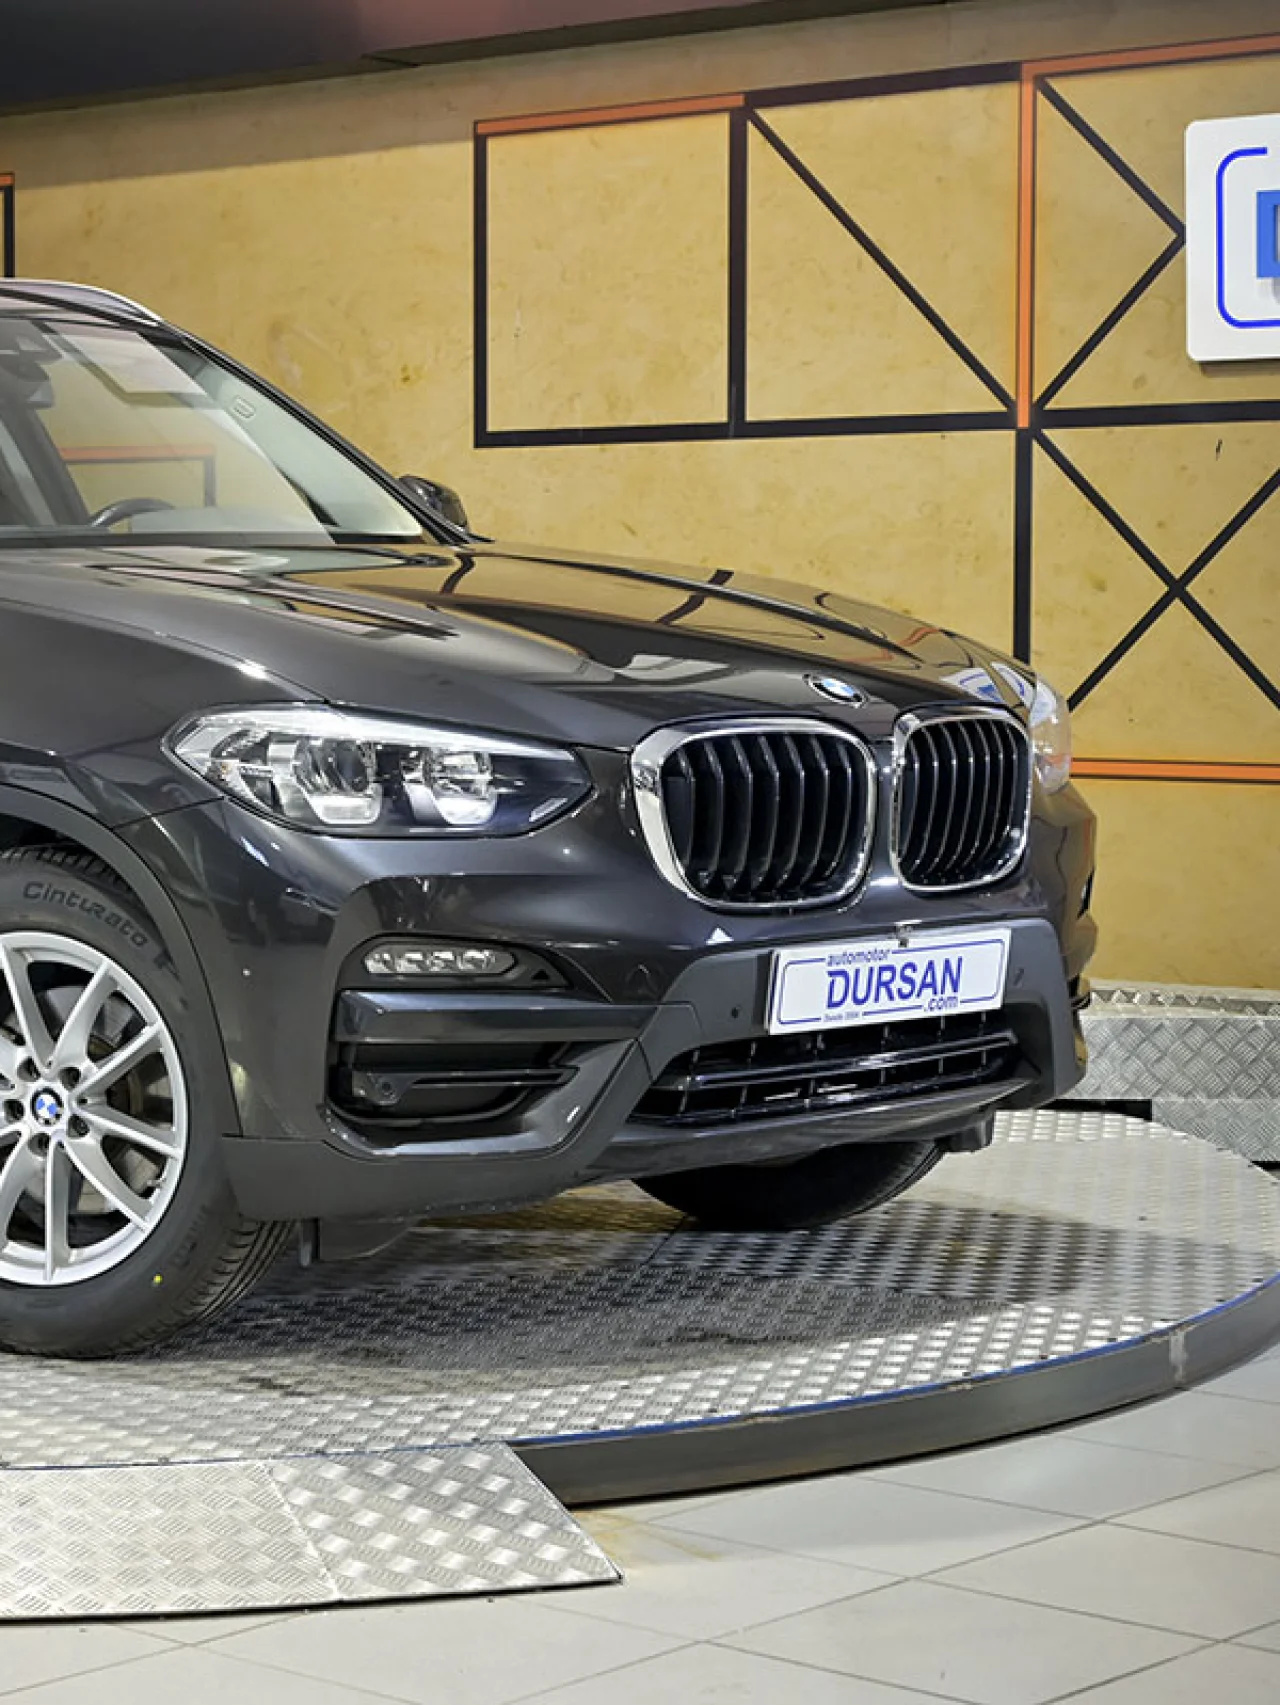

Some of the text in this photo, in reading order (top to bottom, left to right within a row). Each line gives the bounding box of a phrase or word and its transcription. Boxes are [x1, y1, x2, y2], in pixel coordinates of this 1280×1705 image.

[23, 881, 149, 948] Cinturato
[827, 948, 890, 967] automotor
[827, 955, 963, 1010] DURSAN
[923, 995, 959, 1012] .com
